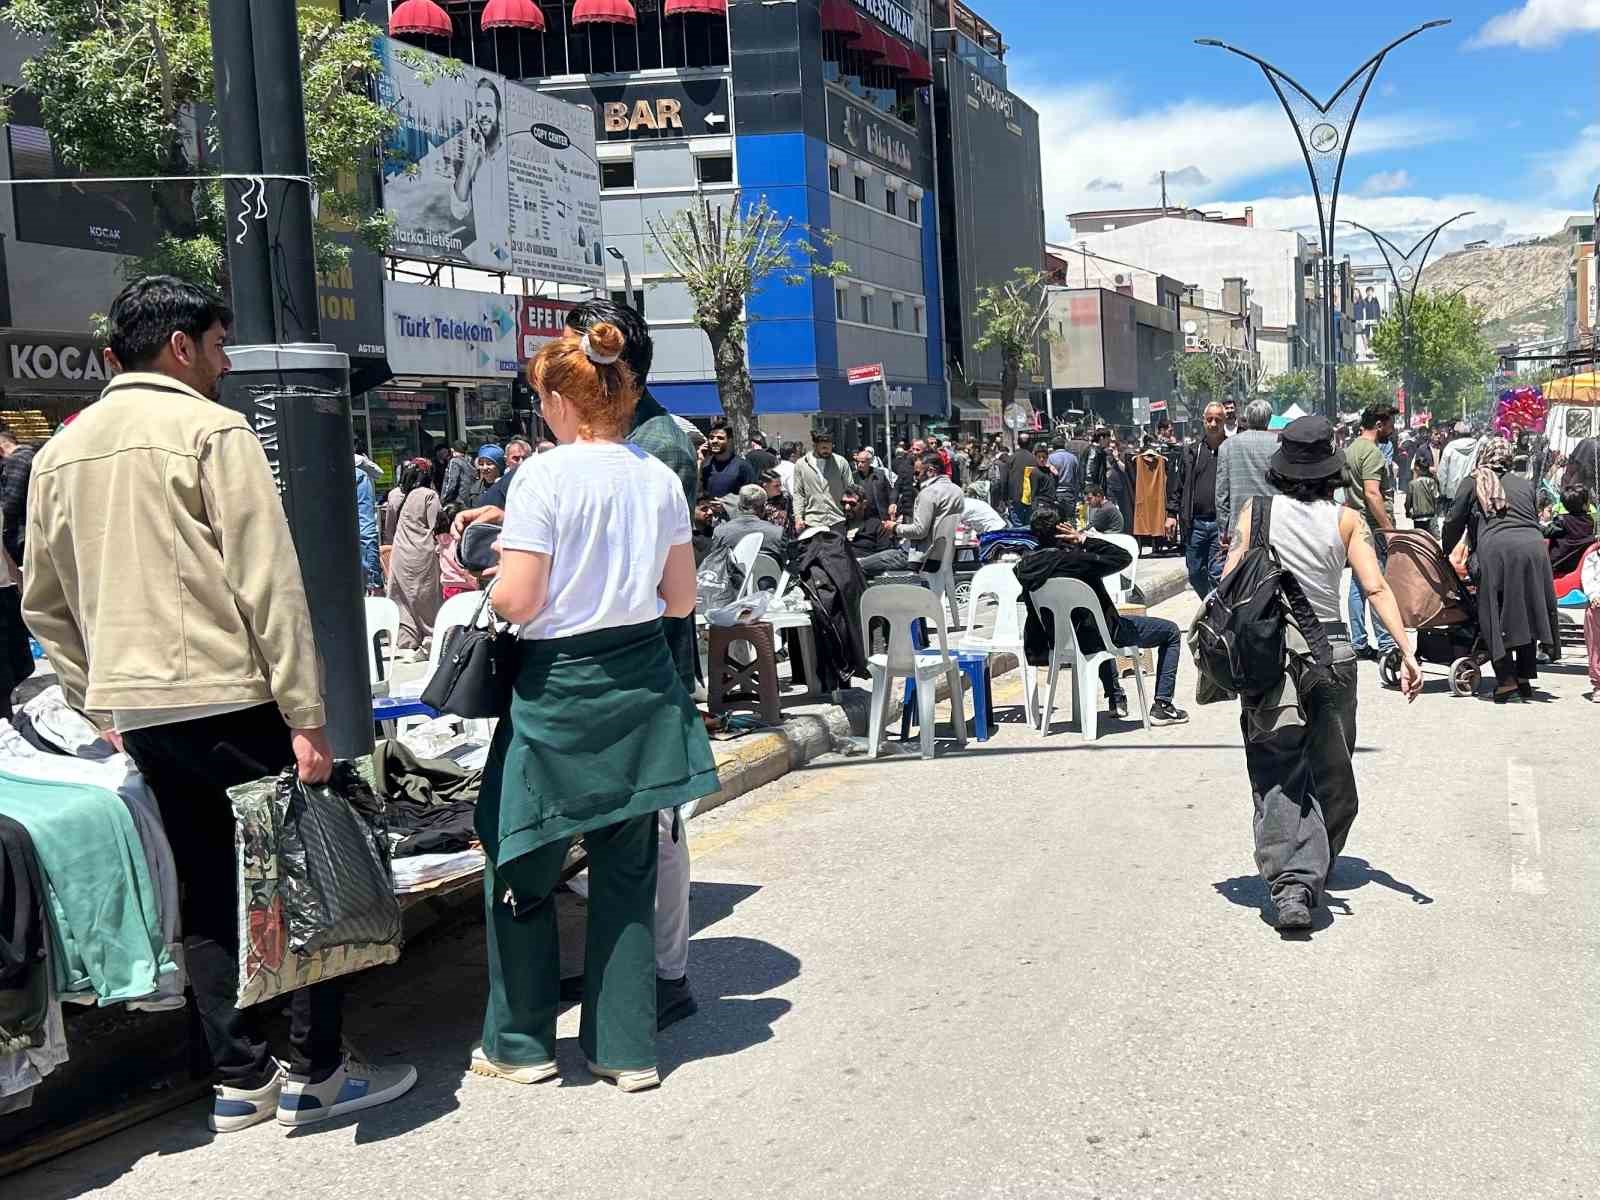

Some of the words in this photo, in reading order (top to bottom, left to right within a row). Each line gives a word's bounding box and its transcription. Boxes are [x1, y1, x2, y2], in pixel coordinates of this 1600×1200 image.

[603, 98, 683, 132] BAR
[320, 295, 355, 320] ION
[528, 306, 552, 329] EFE
[397, 314, 431, 338] Türk
[434, 318, 493, 342] Telekom
[254, 394, 279, 450] VAN
